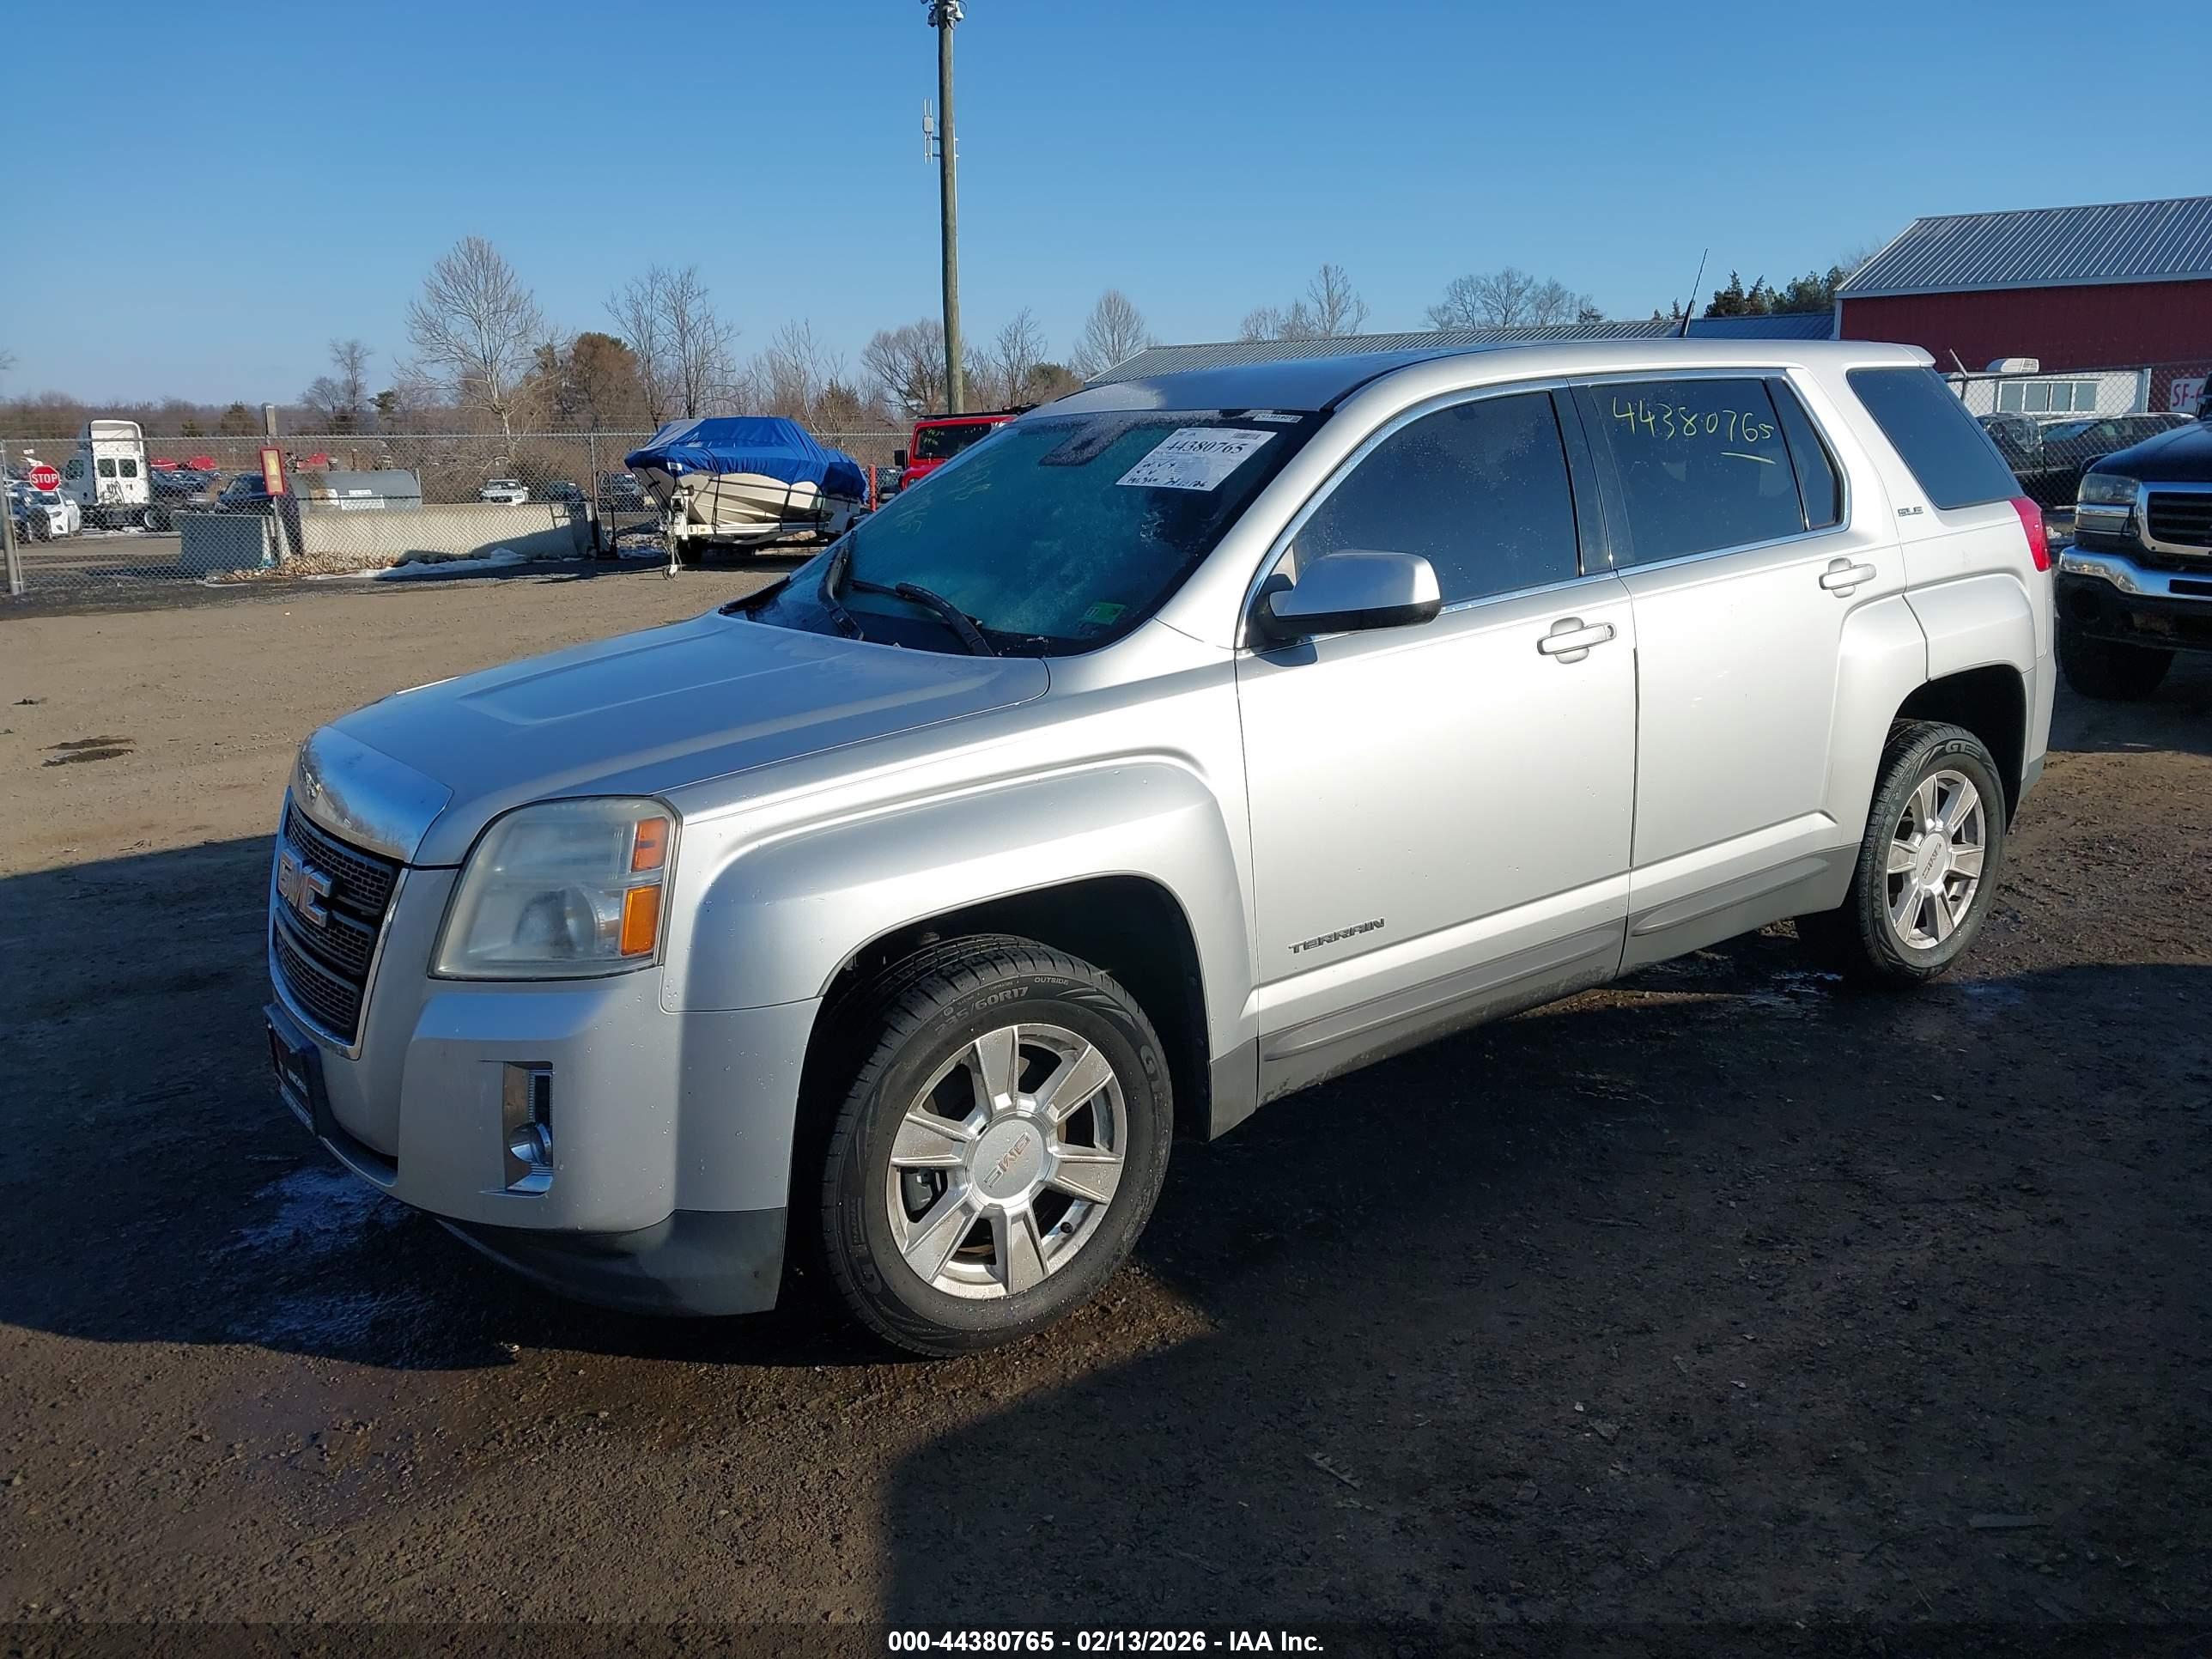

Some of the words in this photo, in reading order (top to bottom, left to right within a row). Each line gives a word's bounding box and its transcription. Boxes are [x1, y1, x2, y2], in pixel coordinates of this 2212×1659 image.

[1613, 396, 1775, 442] 44380765
[1165, 441, 1249, 454] 44380765
[31, 473, 58, 483] STOP
[1897, 506, 1924, 517] SLE
[277, 848, 332, 928] GMC
[1287, 917, 1385, 954] TERRAIN
[1033, 976, 1070, 986] OUTSIDE
[983, 1133, 1031, 1188] GMC
